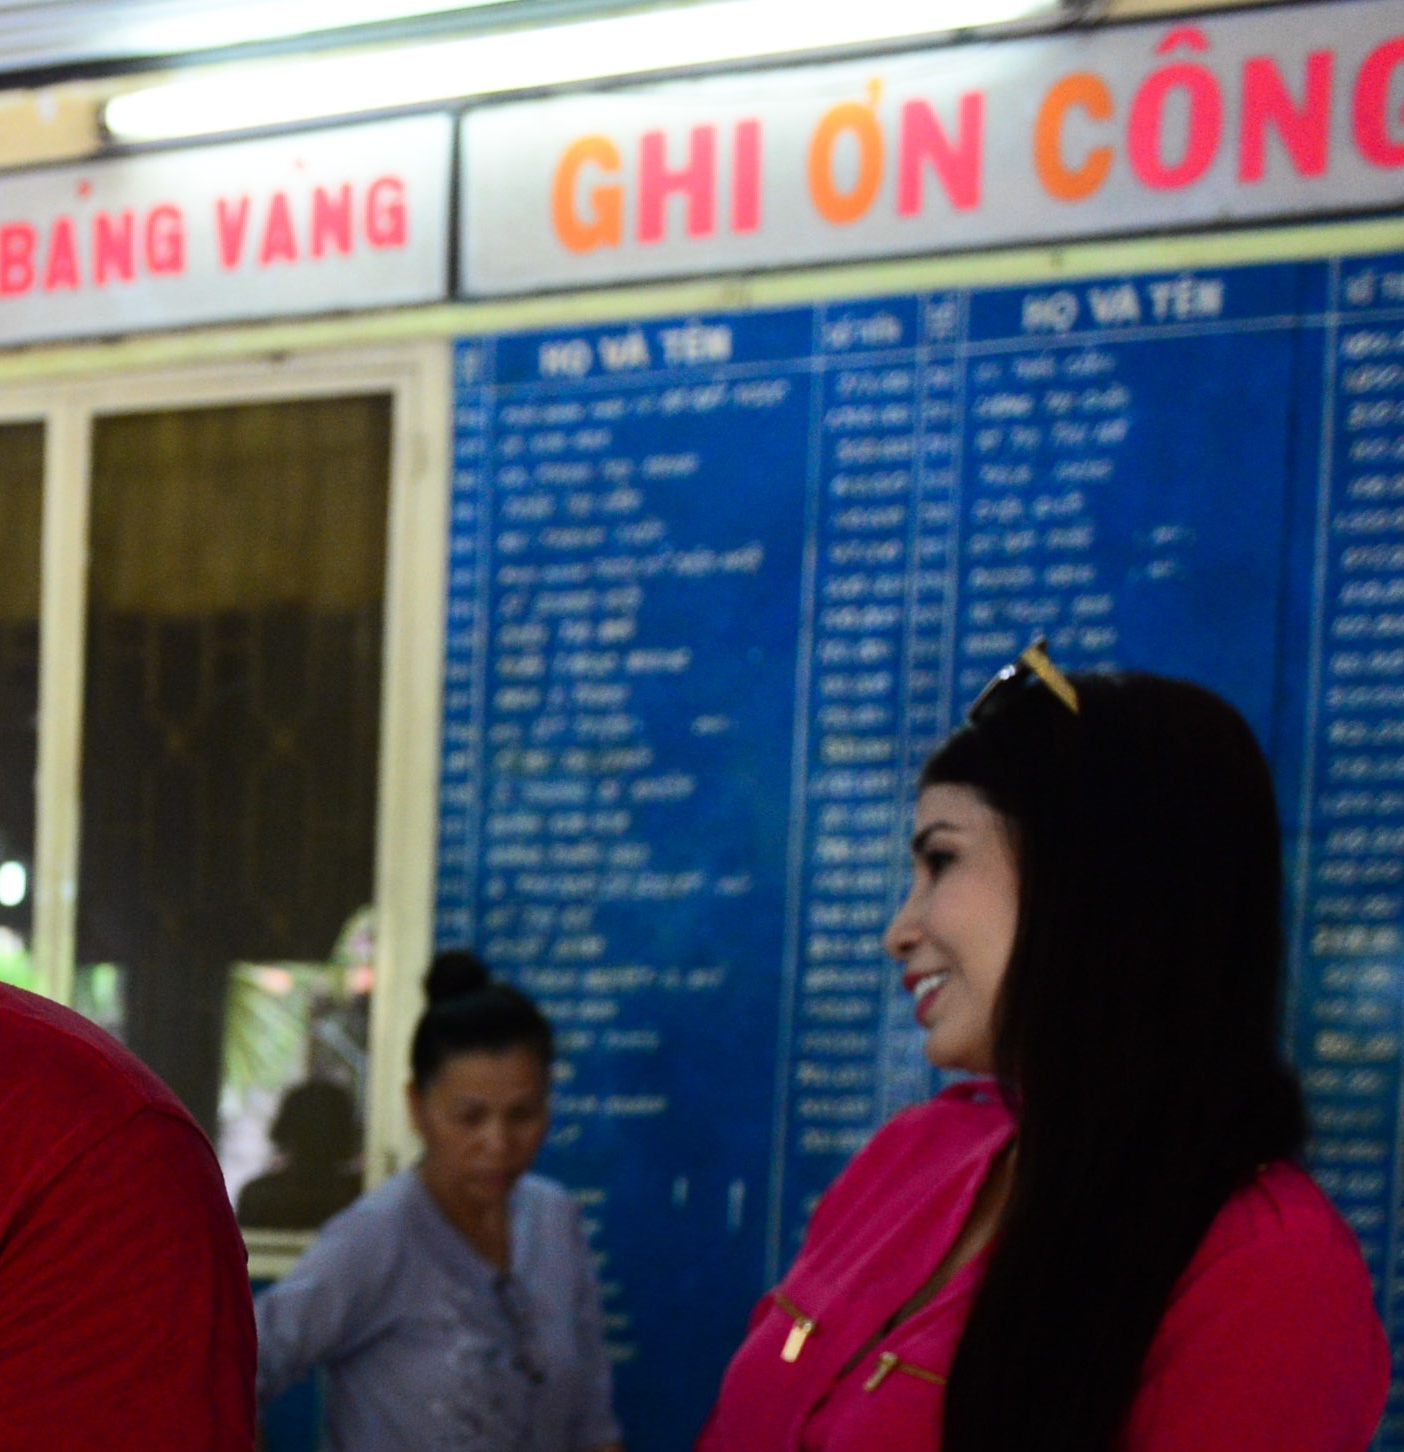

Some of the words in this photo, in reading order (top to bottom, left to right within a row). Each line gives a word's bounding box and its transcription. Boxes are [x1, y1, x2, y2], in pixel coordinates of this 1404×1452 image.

[549, 117, 761, 255] GHI
[806, 76, 988, 226] ƠN
[1031, 27, 1404, 201] CÔNG
